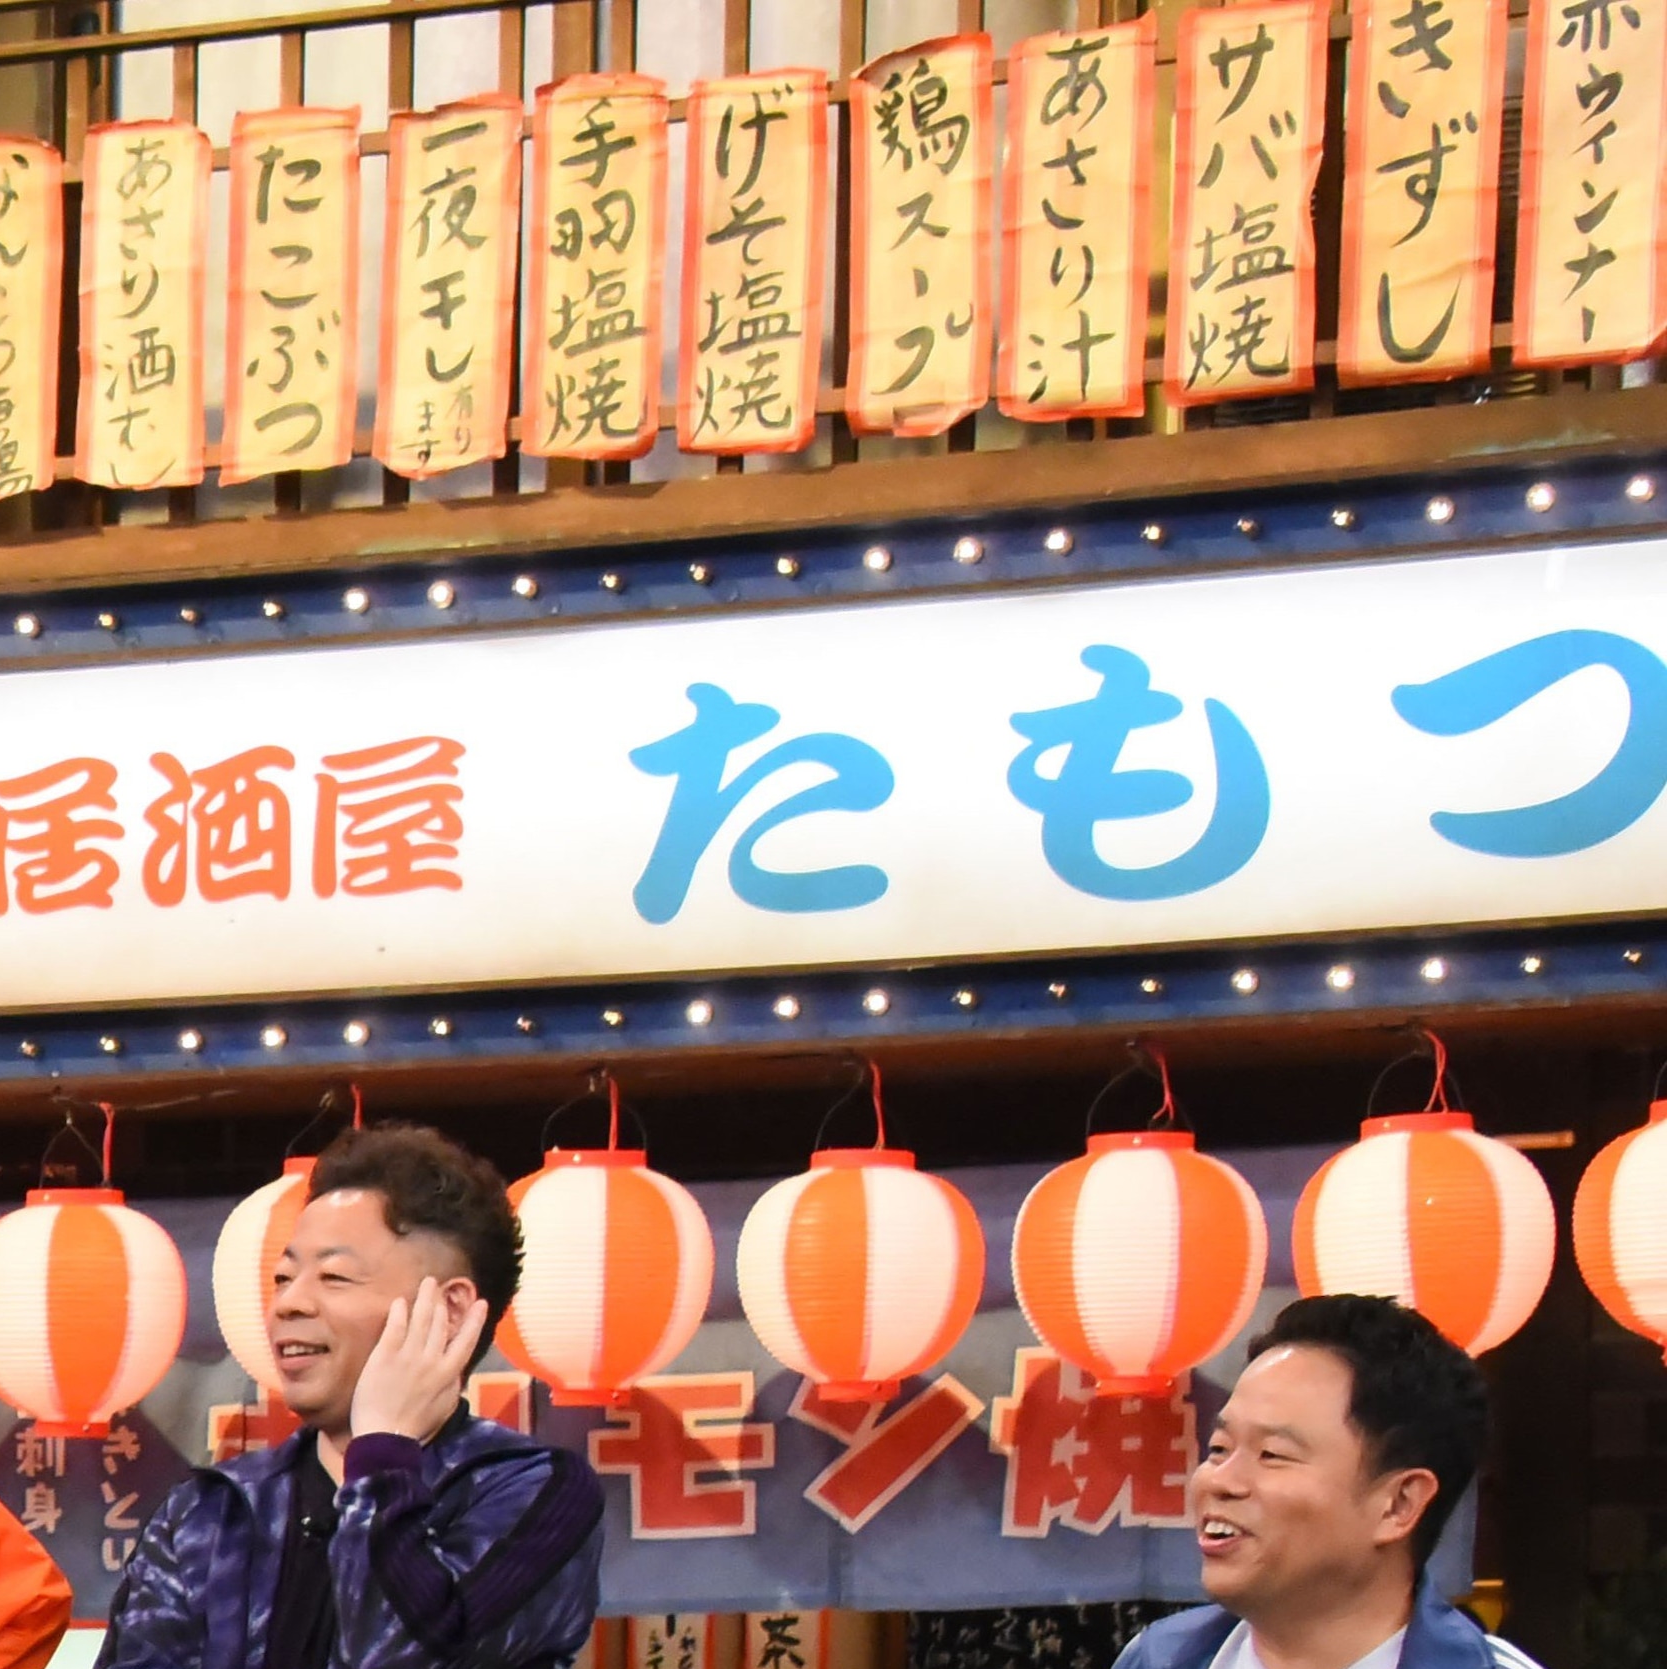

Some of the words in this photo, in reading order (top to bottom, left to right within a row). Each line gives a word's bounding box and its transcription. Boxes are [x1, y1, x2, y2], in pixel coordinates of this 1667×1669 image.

[107, 138, 177, 488] あさり酒むし
[247, 146, 343, 455] たこぶつ
[410, 121, 489, 383] 一夜干し
[694, 84, 802, 441] げそ塩焼
[873, 56, 976, 394] 鶏スープ
[1028, 36, 1116, 404] あさり汁
[1185, 23, 1296, 391] サバ塩焼
[629, 627, 1667, 924] たもつ
[101, 1410, 141, 1572] きとり
